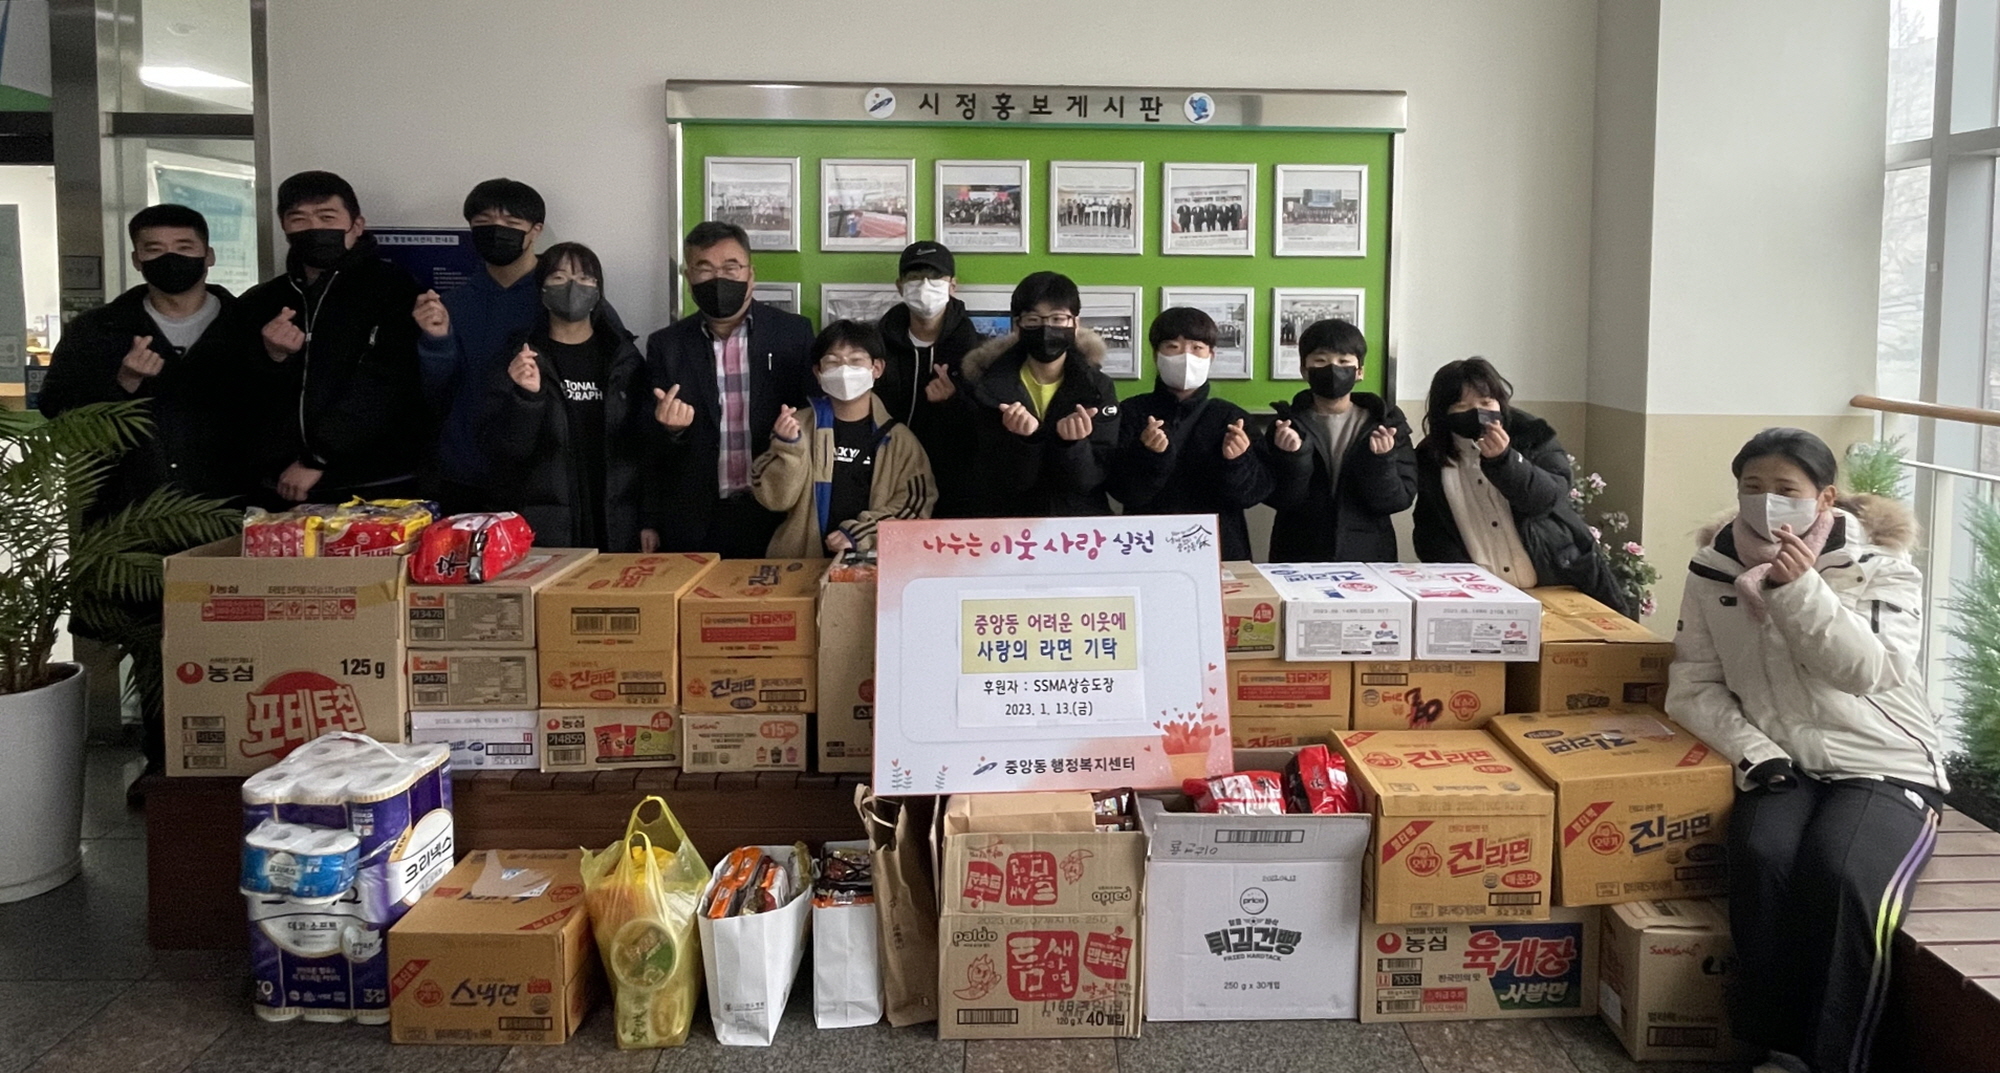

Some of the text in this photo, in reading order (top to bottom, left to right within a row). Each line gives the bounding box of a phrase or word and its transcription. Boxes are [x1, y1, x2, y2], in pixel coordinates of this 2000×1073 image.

[919, 92, 1163, 121] 시정홍보게시판
[923, 528, 1155, 561] 나누는 이웃 사랑 실천
[974, 611, 1127, 636] 중앙동 어려운 이웃에
[977, 637, 1118, 663] 사랑의 라면 기탁
[208, 665, 254, 683] 농심
[340, 659, 385, 679] 125 g
[569, 668, 616, 690] 진라면
[710, 678, 756, 699] 진라면
[983, 680, 1019, 695] 후원자
[1033, 678, 1115, 694] SSMA상승도장
[1005, 702, 1094, 717] 2023. 1. 13.(금)
[240, 684, 367, 757] 포테토칩
[1004, 757, 1136, 776] 중앙동 행정복지센터
[1403, 750, 1496, 770] 진라면
[1629, 813, 1712, 855] 진라면
[405, 836, 452, 884] 크리넥스
[1446, 837, 1531, 877] 진라면
[1092, 886, 1131, 906] paldo
[1243, 897, 1265, 905] price
[952, 926, 998, 947] paldo
[1204, 926, 1302, 956] 튀김건빵
[1406, 935, 1447, 953] 농심
[1087, 947, 1129, 968] 맵부심
[1463, 930, 1577, 978] 육개장
[450, 978, 521, 1007] 스낵면
[1223, 981, 1239, 990] 250
[1500, 982, 1568, 1003] 사발면
[1056, 1017, 1070, 1025] 120
